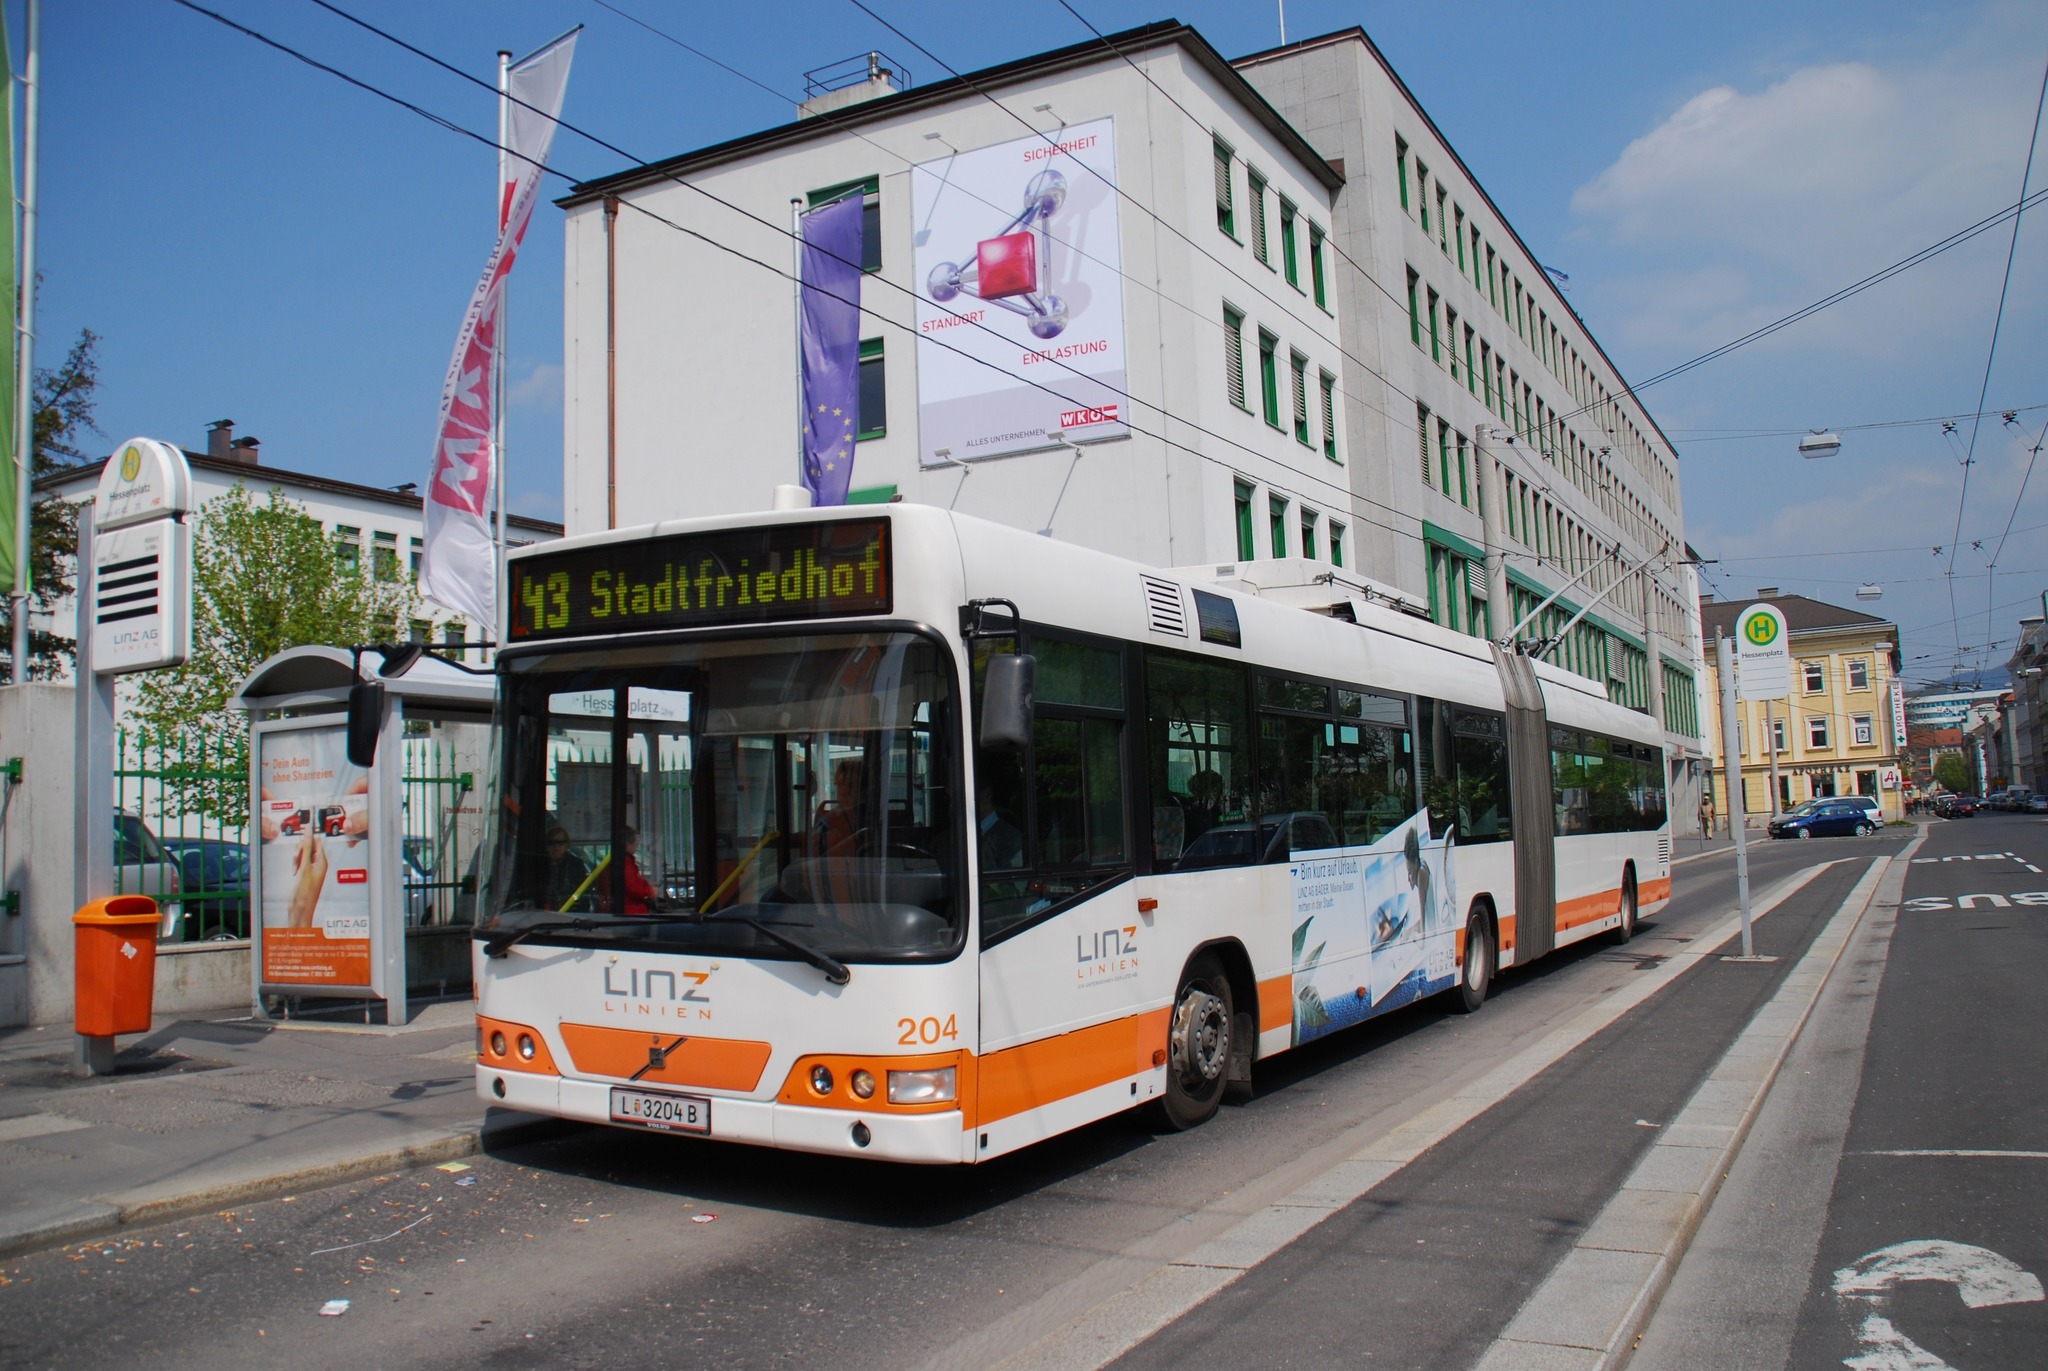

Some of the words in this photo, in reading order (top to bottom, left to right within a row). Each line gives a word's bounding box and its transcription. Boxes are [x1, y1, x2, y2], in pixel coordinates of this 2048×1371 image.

[1023, 135, 1098, 163] SICHERHEIT
[922, 310, 985, 333] STANDORT
[1022, 339, 1108, 366] ENTLASTUNG
[965, 436, 989, 448] ALLES
[990, 428, 1048, 444] UNTERNEHMEN.
[109, 484, 151, 502] Hessenplatz
[522, 571, 570, 630] 43
[590, 540, 880, 618] Stadtfriedhof
[113, 631, 139, 645] LINZ
[142, 628, 158, 640] AG
[1753, 619, 1770, 639] H
[1741, 650, 1783, 659] Hessenplatz
[582, 694, 659, 714] Hessplatz
[1893, 683, 1904, 734] APOTHEKE
[272, 758, 289, 769] Dein
[292, 757, 310, 768] Auto
[1792, 765, 1850, 776] APOTHEKE
[272, 773, 291, 783] ohne
[1911, 853, 2006, 864] BUS
[1300, 862, 1312, 880] Bin
[1312, 861, 1326, 878] kurz
[1327, 858, 1338, 877] auf
[1298, 886, 1308, 899] LINZ
[1309, 885, 1314, 897] AG
[1903, 891, 2048, 913] BUS
[326, 919, 350, 928] LINZ
[352, 919, 367, 928] AG
[1077, 925, 1138, 963] LINZ
[1077, 958, 1138, 979] LINIEN
[603, 966, 711, 1003] LINZ
[604, 1000, 712, 1021] LINIEN
[896, 1014, 959, 1047] 204
[622, 1096, 630, 1115] L
[643, 1099, 682, 1122] 3204
[687, 1104, 697, 1123] B
[647, 1122, 670, 1130] VOLVO
